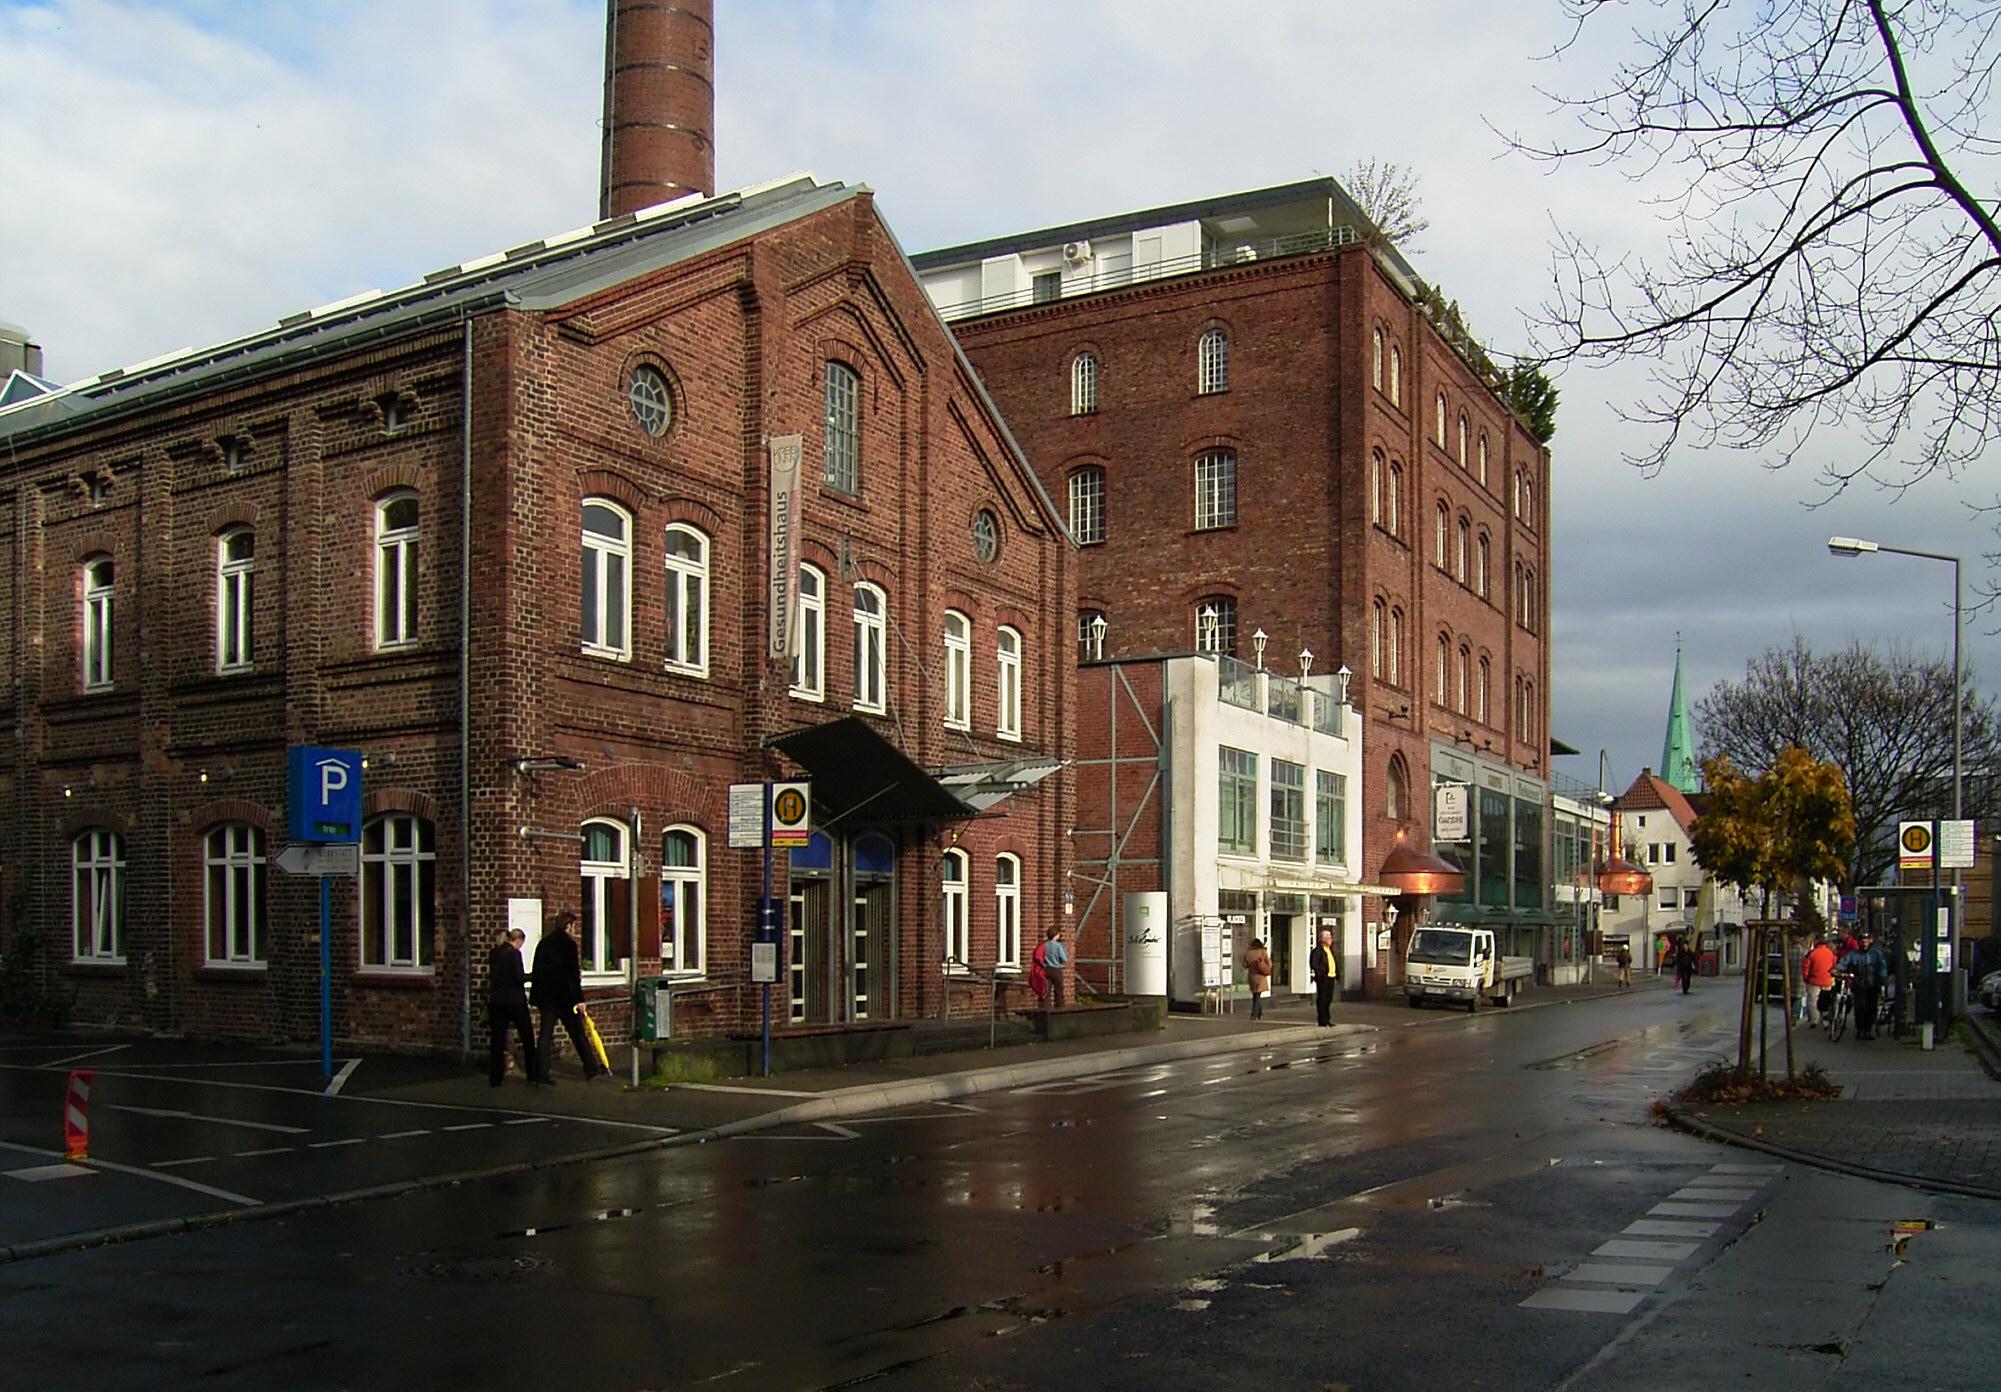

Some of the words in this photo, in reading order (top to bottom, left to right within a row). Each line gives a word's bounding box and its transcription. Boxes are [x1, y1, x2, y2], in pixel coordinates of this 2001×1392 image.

[773, 491, 788, 653] Gesundheitshaus
[322, 765, 347, 805] P
[784, 797, 797, 816] H
[1910, 832, 1922, 846] H
